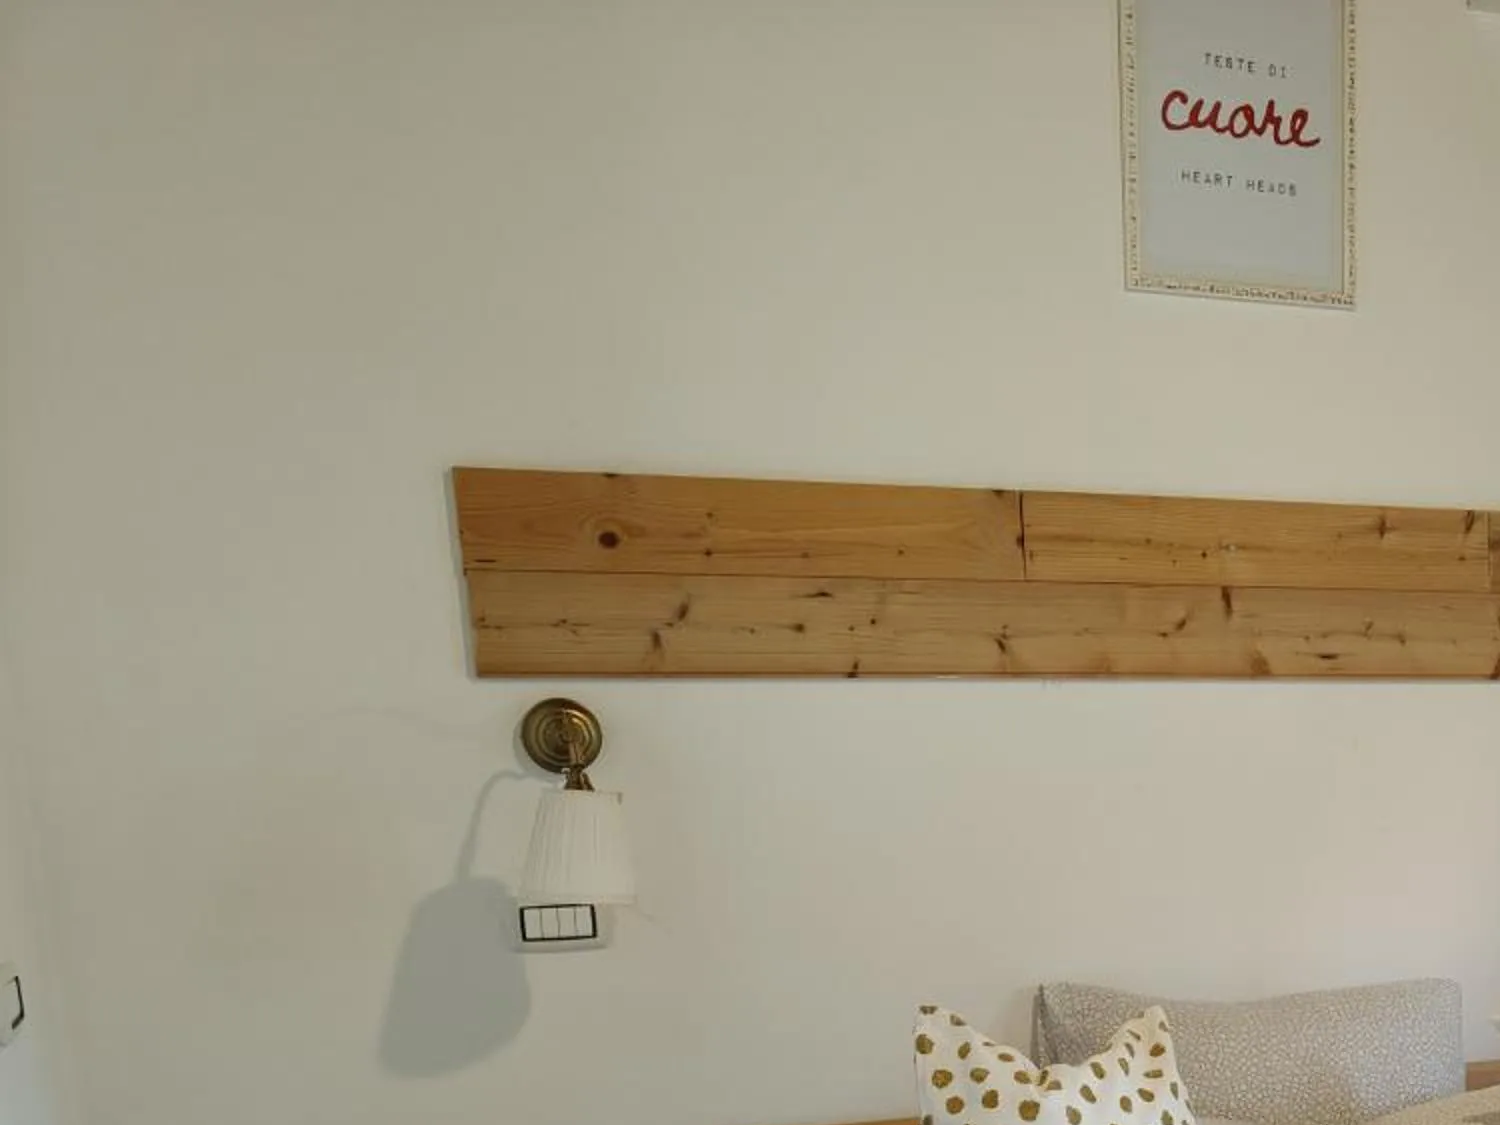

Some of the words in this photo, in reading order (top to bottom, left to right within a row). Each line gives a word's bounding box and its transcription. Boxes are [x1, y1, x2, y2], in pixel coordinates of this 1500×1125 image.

[1204, 52, 1256, 74] TESTE
[1268, 63, 1287, 79] DI
[1181, 169, 1233, 189] HEART
[1246, 178, 1297, 197] HEADS
